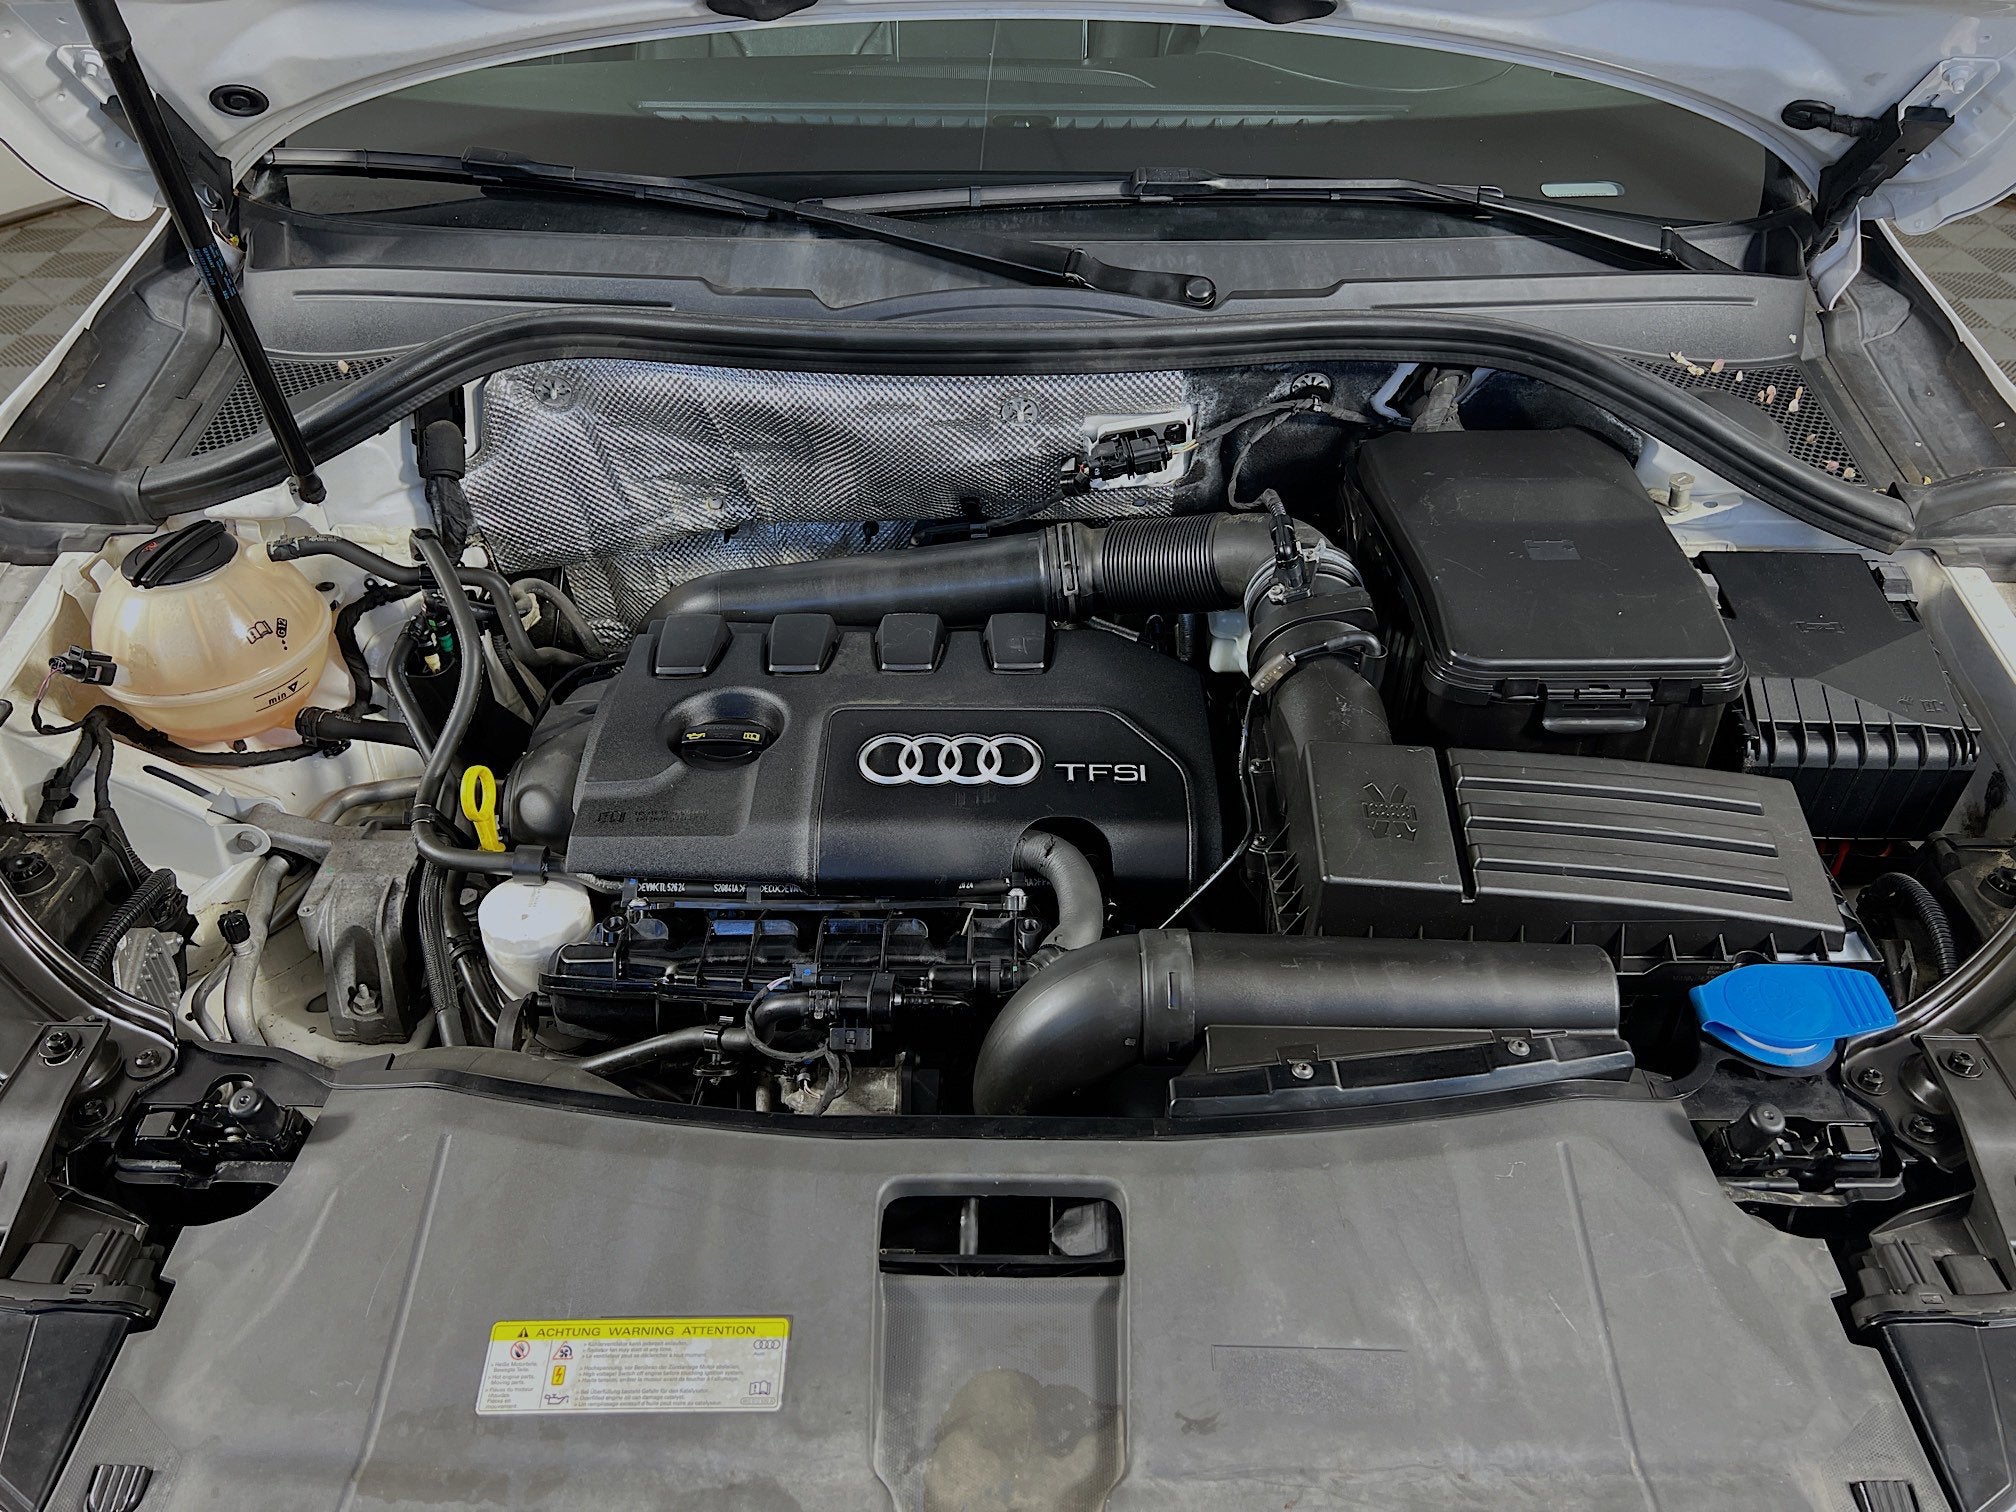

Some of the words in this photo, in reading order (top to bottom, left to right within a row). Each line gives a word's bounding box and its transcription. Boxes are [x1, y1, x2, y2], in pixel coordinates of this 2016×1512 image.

[268, 692, 286, 706] min
[1054, 764, 1146, 782] TFSI
[536, 1327, 600, 1337] ACHTUNG
[608, 1326, 674, 1336] WARNING
[681, 1326, 756, 1335] ATTENTION
